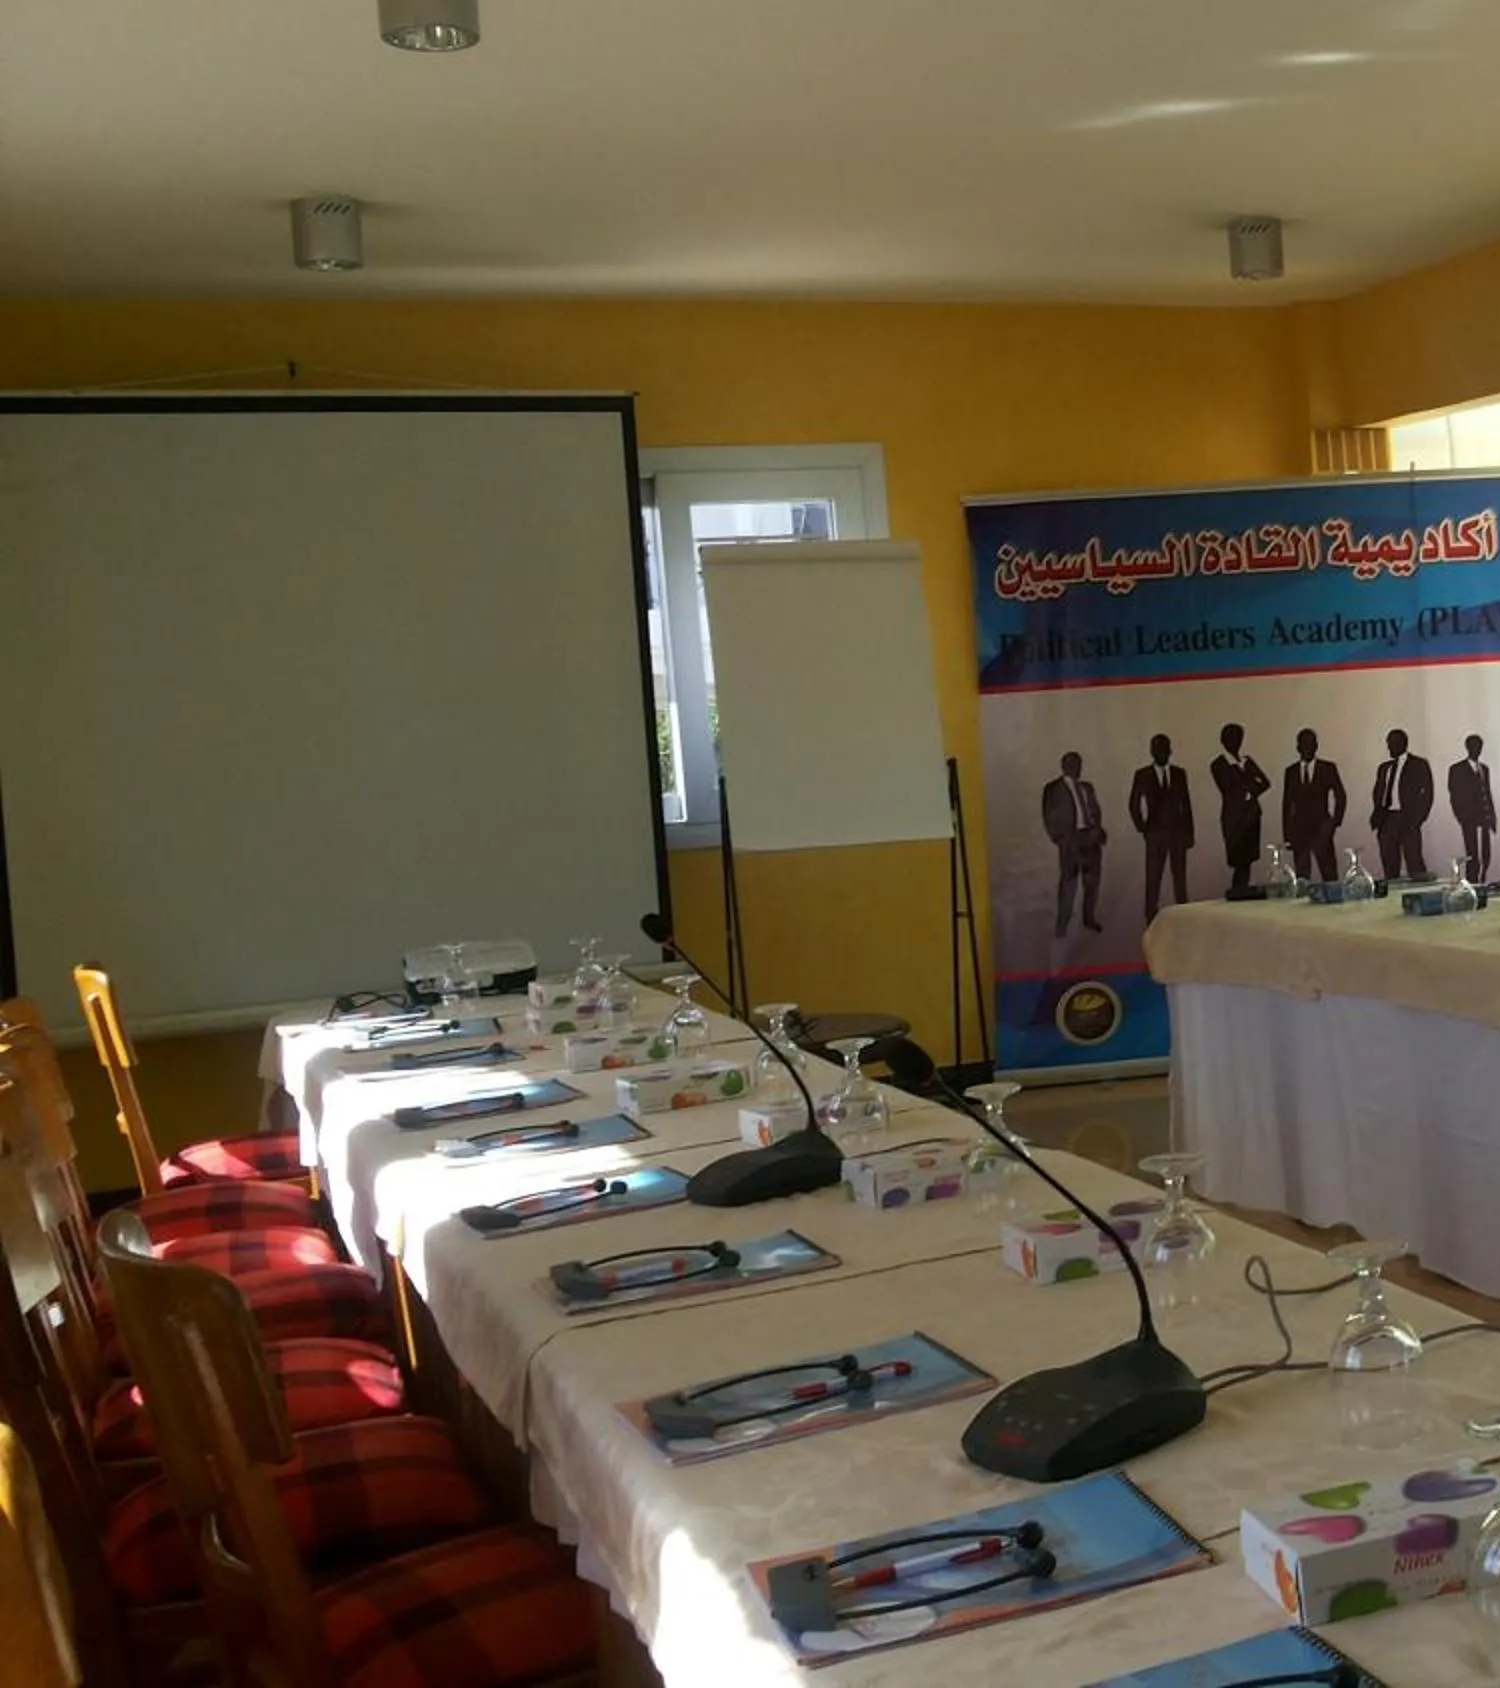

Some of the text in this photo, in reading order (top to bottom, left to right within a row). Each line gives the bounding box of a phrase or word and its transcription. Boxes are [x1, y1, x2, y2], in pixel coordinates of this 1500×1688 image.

[994, 508, 1499, 602] أكاديمية القادة السياسيين
[1135, 620, 1256, 655] Leaders
[1268, 613, 1405, 648] Academy
